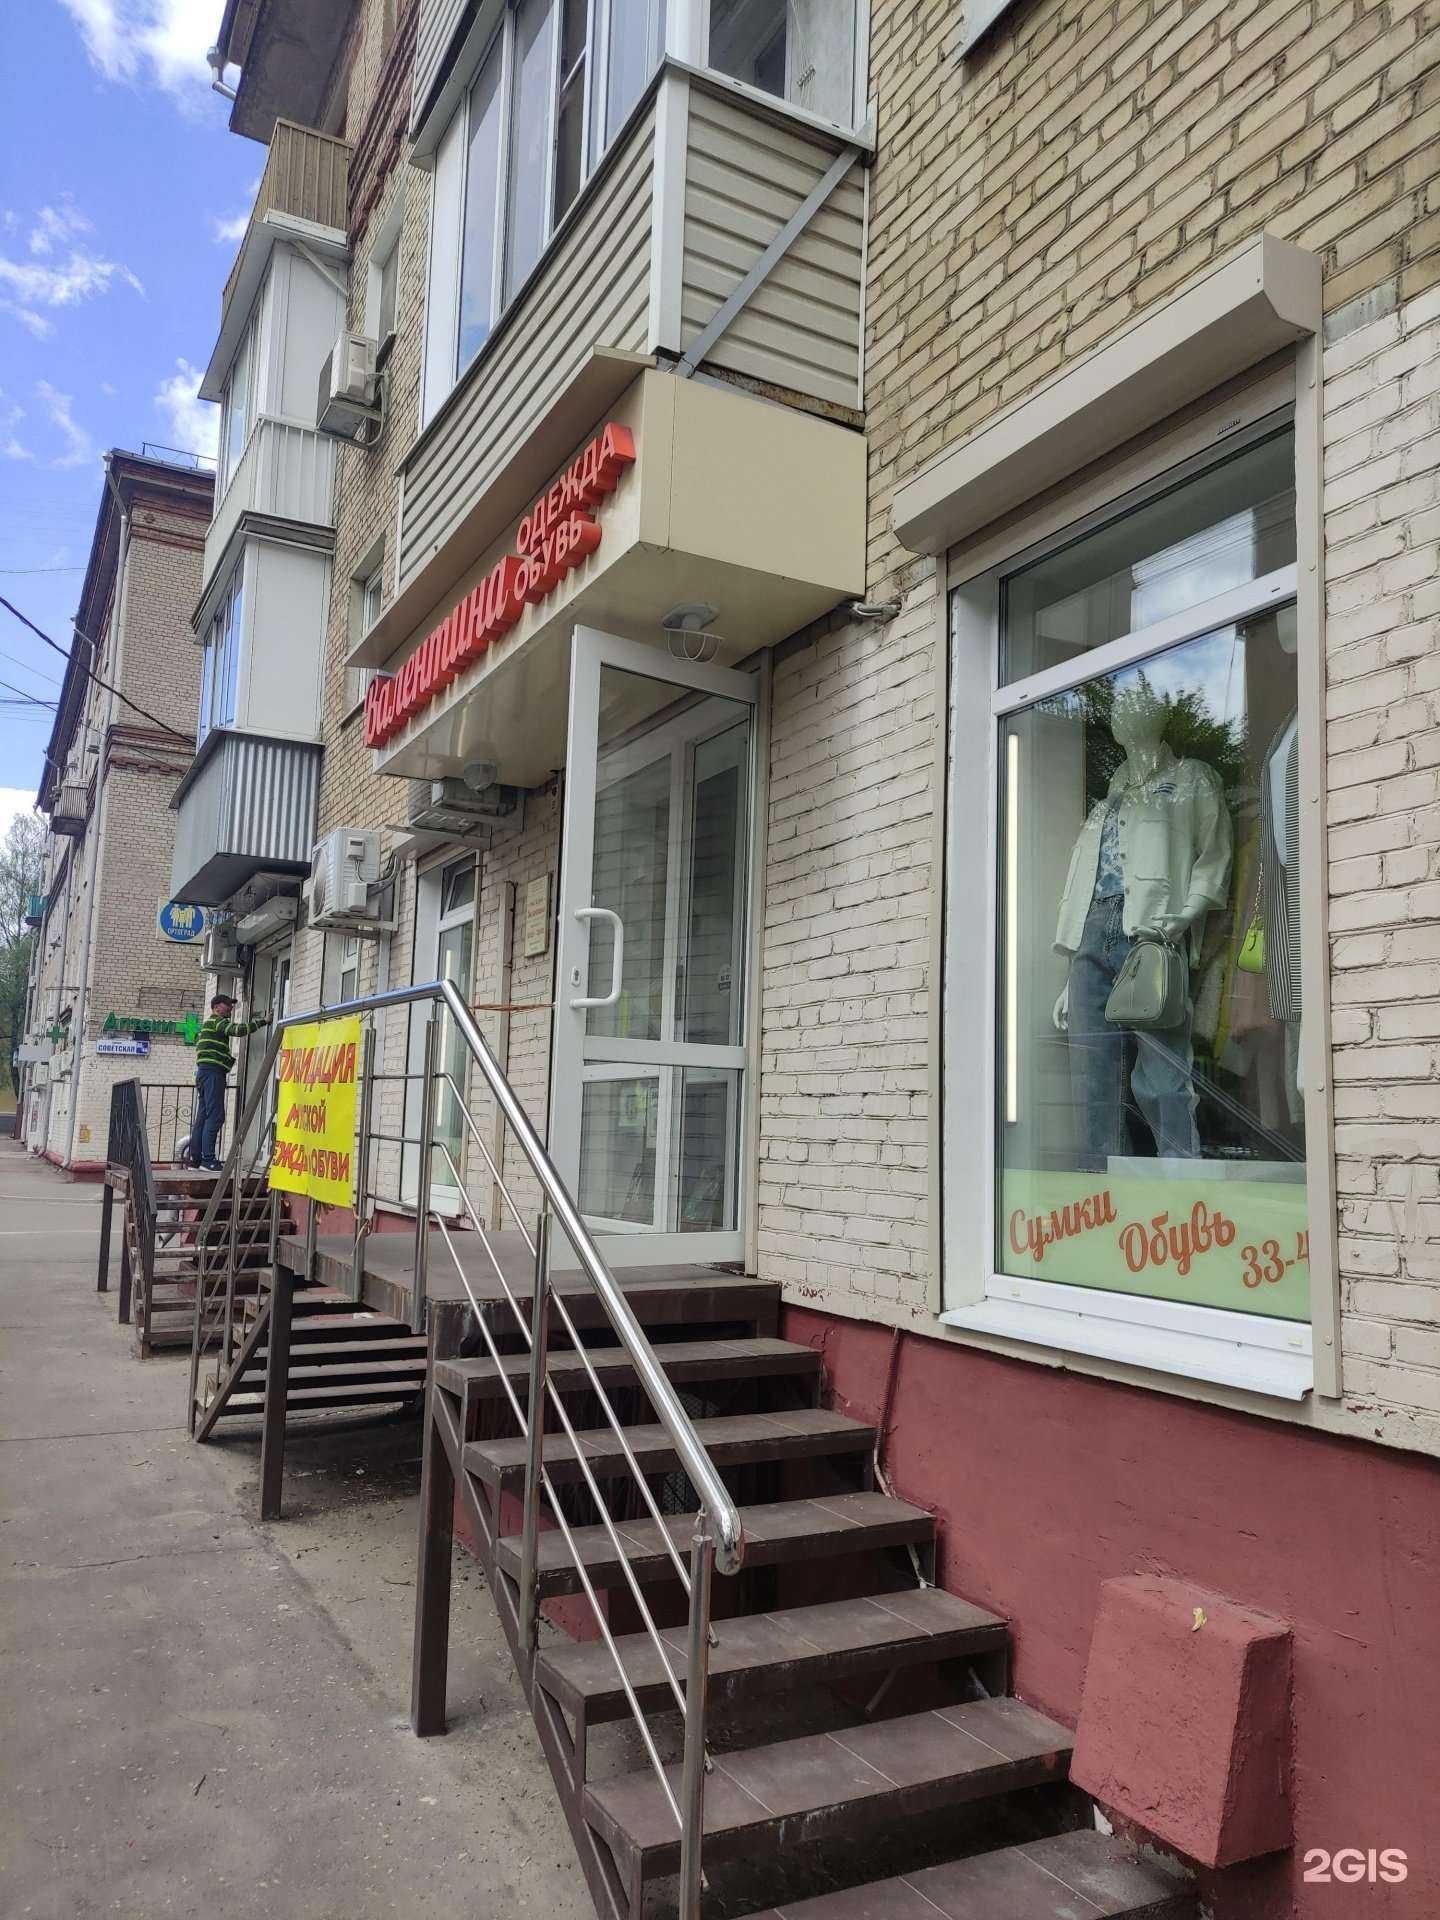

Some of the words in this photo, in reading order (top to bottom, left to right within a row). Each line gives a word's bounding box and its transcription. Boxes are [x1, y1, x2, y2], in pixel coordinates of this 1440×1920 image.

[516, 422, 636, 554] ОДЕЖДА
[514, 510, 601, 604] ОБУВЬ
[364, 555, 524, 749] Валентина
[98, 1044, 135, 1053] СОВЕТСКАЯ
[310, 1148, 350, 1182] ОБУВИ
[1010, 1190, 1118, 1262] Сумки
[1119, 1200, 1236, 1276] Обувь
